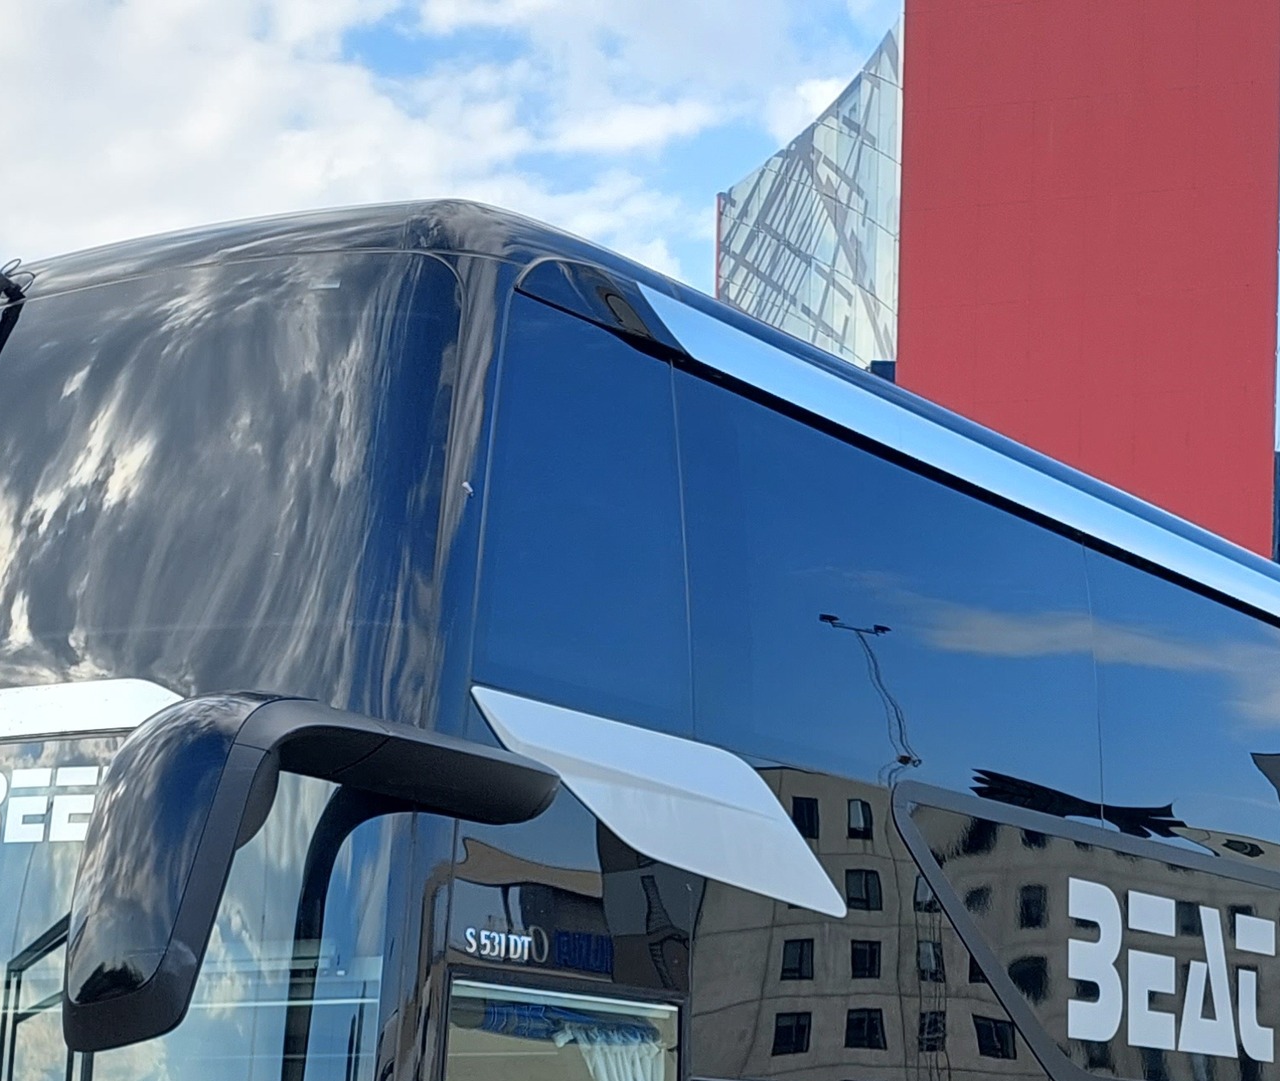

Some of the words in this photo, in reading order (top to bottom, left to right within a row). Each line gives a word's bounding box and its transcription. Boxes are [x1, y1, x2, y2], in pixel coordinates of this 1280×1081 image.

[465, 927, 477, 953] S
[480, 929, 506, 958] 531
[508, 934, 532, 960] DT
[1068, 877, 1276, 1063] BEAT
